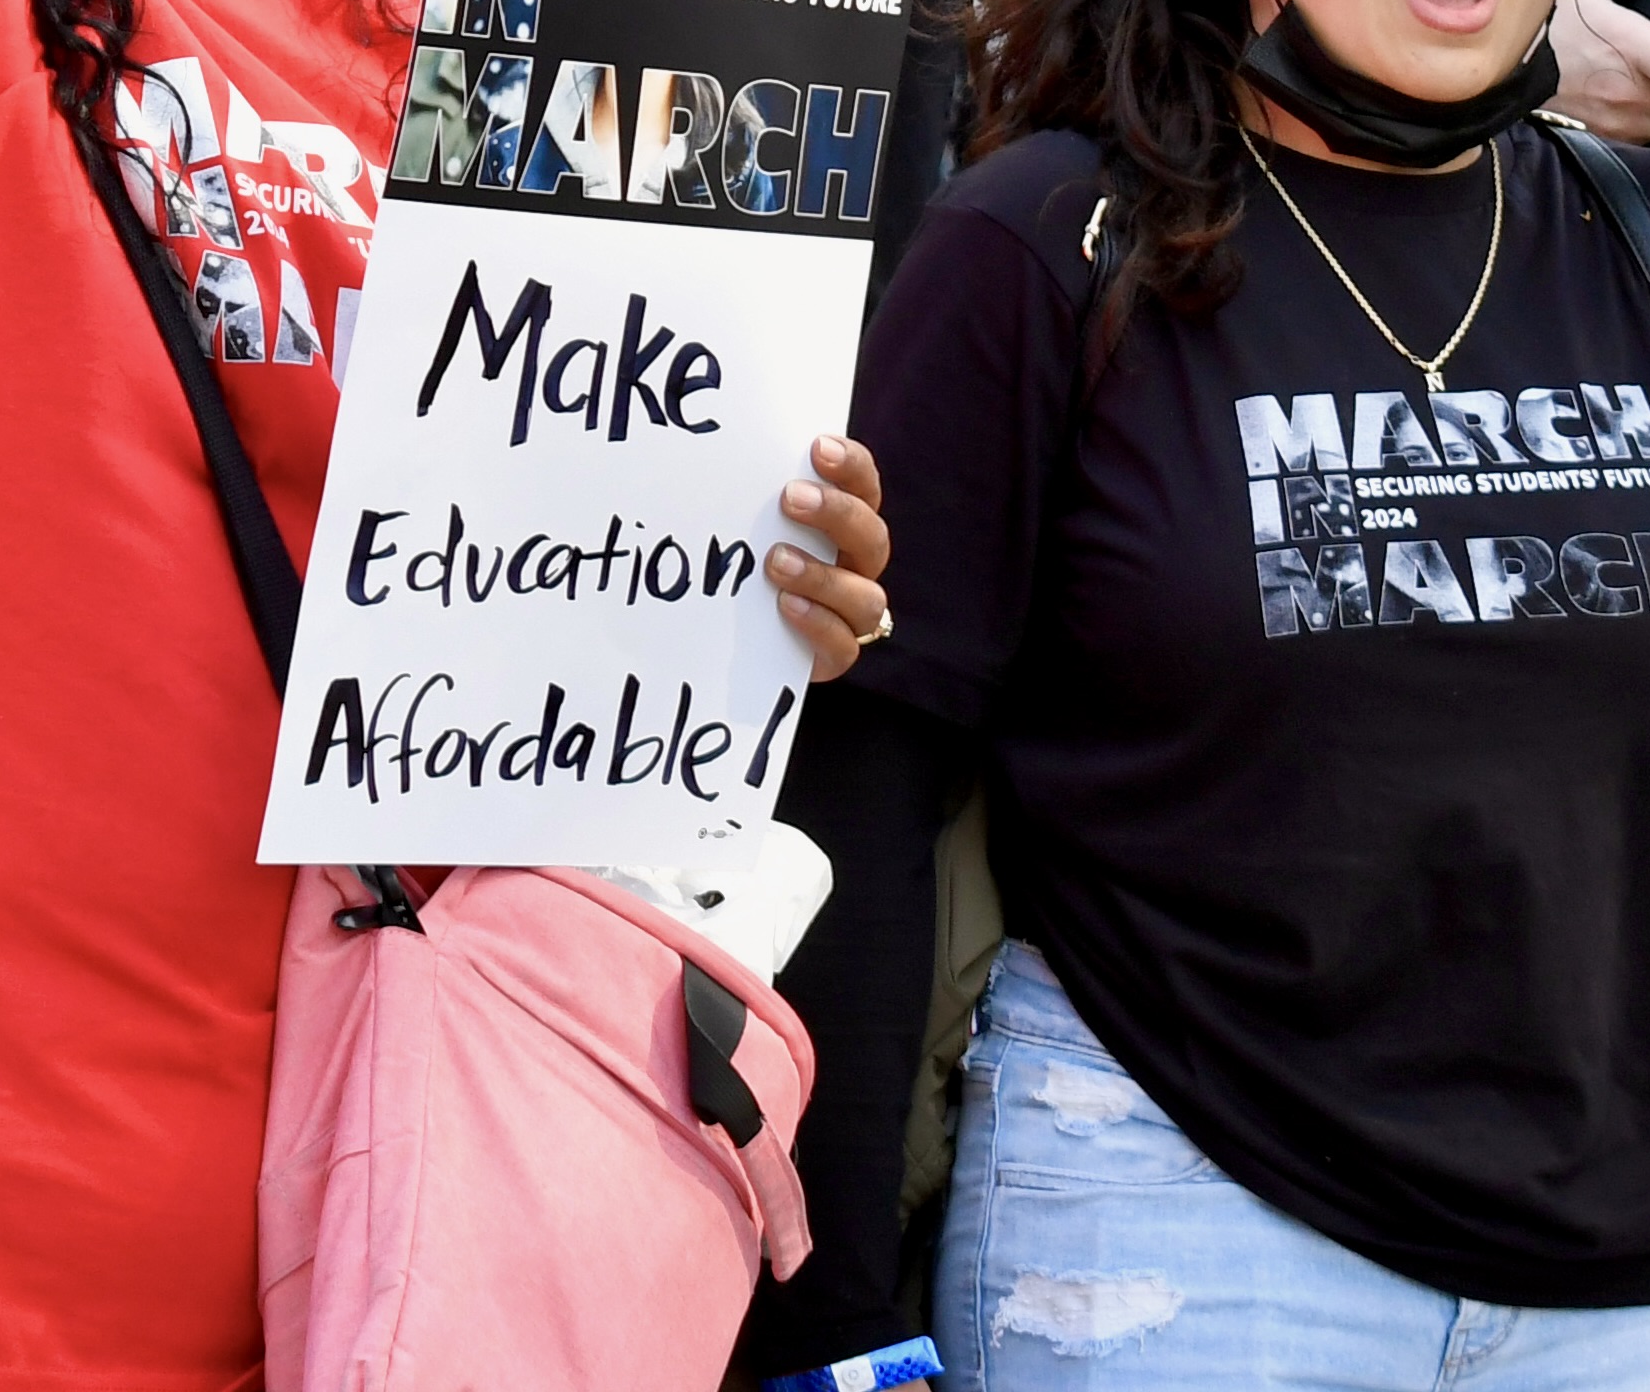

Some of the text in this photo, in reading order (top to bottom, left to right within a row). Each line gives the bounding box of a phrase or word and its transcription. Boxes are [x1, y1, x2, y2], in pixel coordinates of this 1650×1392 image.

[390, 44, 892, 223] MARCH
[416, 259, 722, 448] Make
[1248, 473, 1360, 546] IN
[1353, 471, 1474, 499] SECURING
[1475, 468, 1602, 495] STUDENTS'
[1360, 507, 1419, 530] 2024
[345, 503, 757, 608] Education
